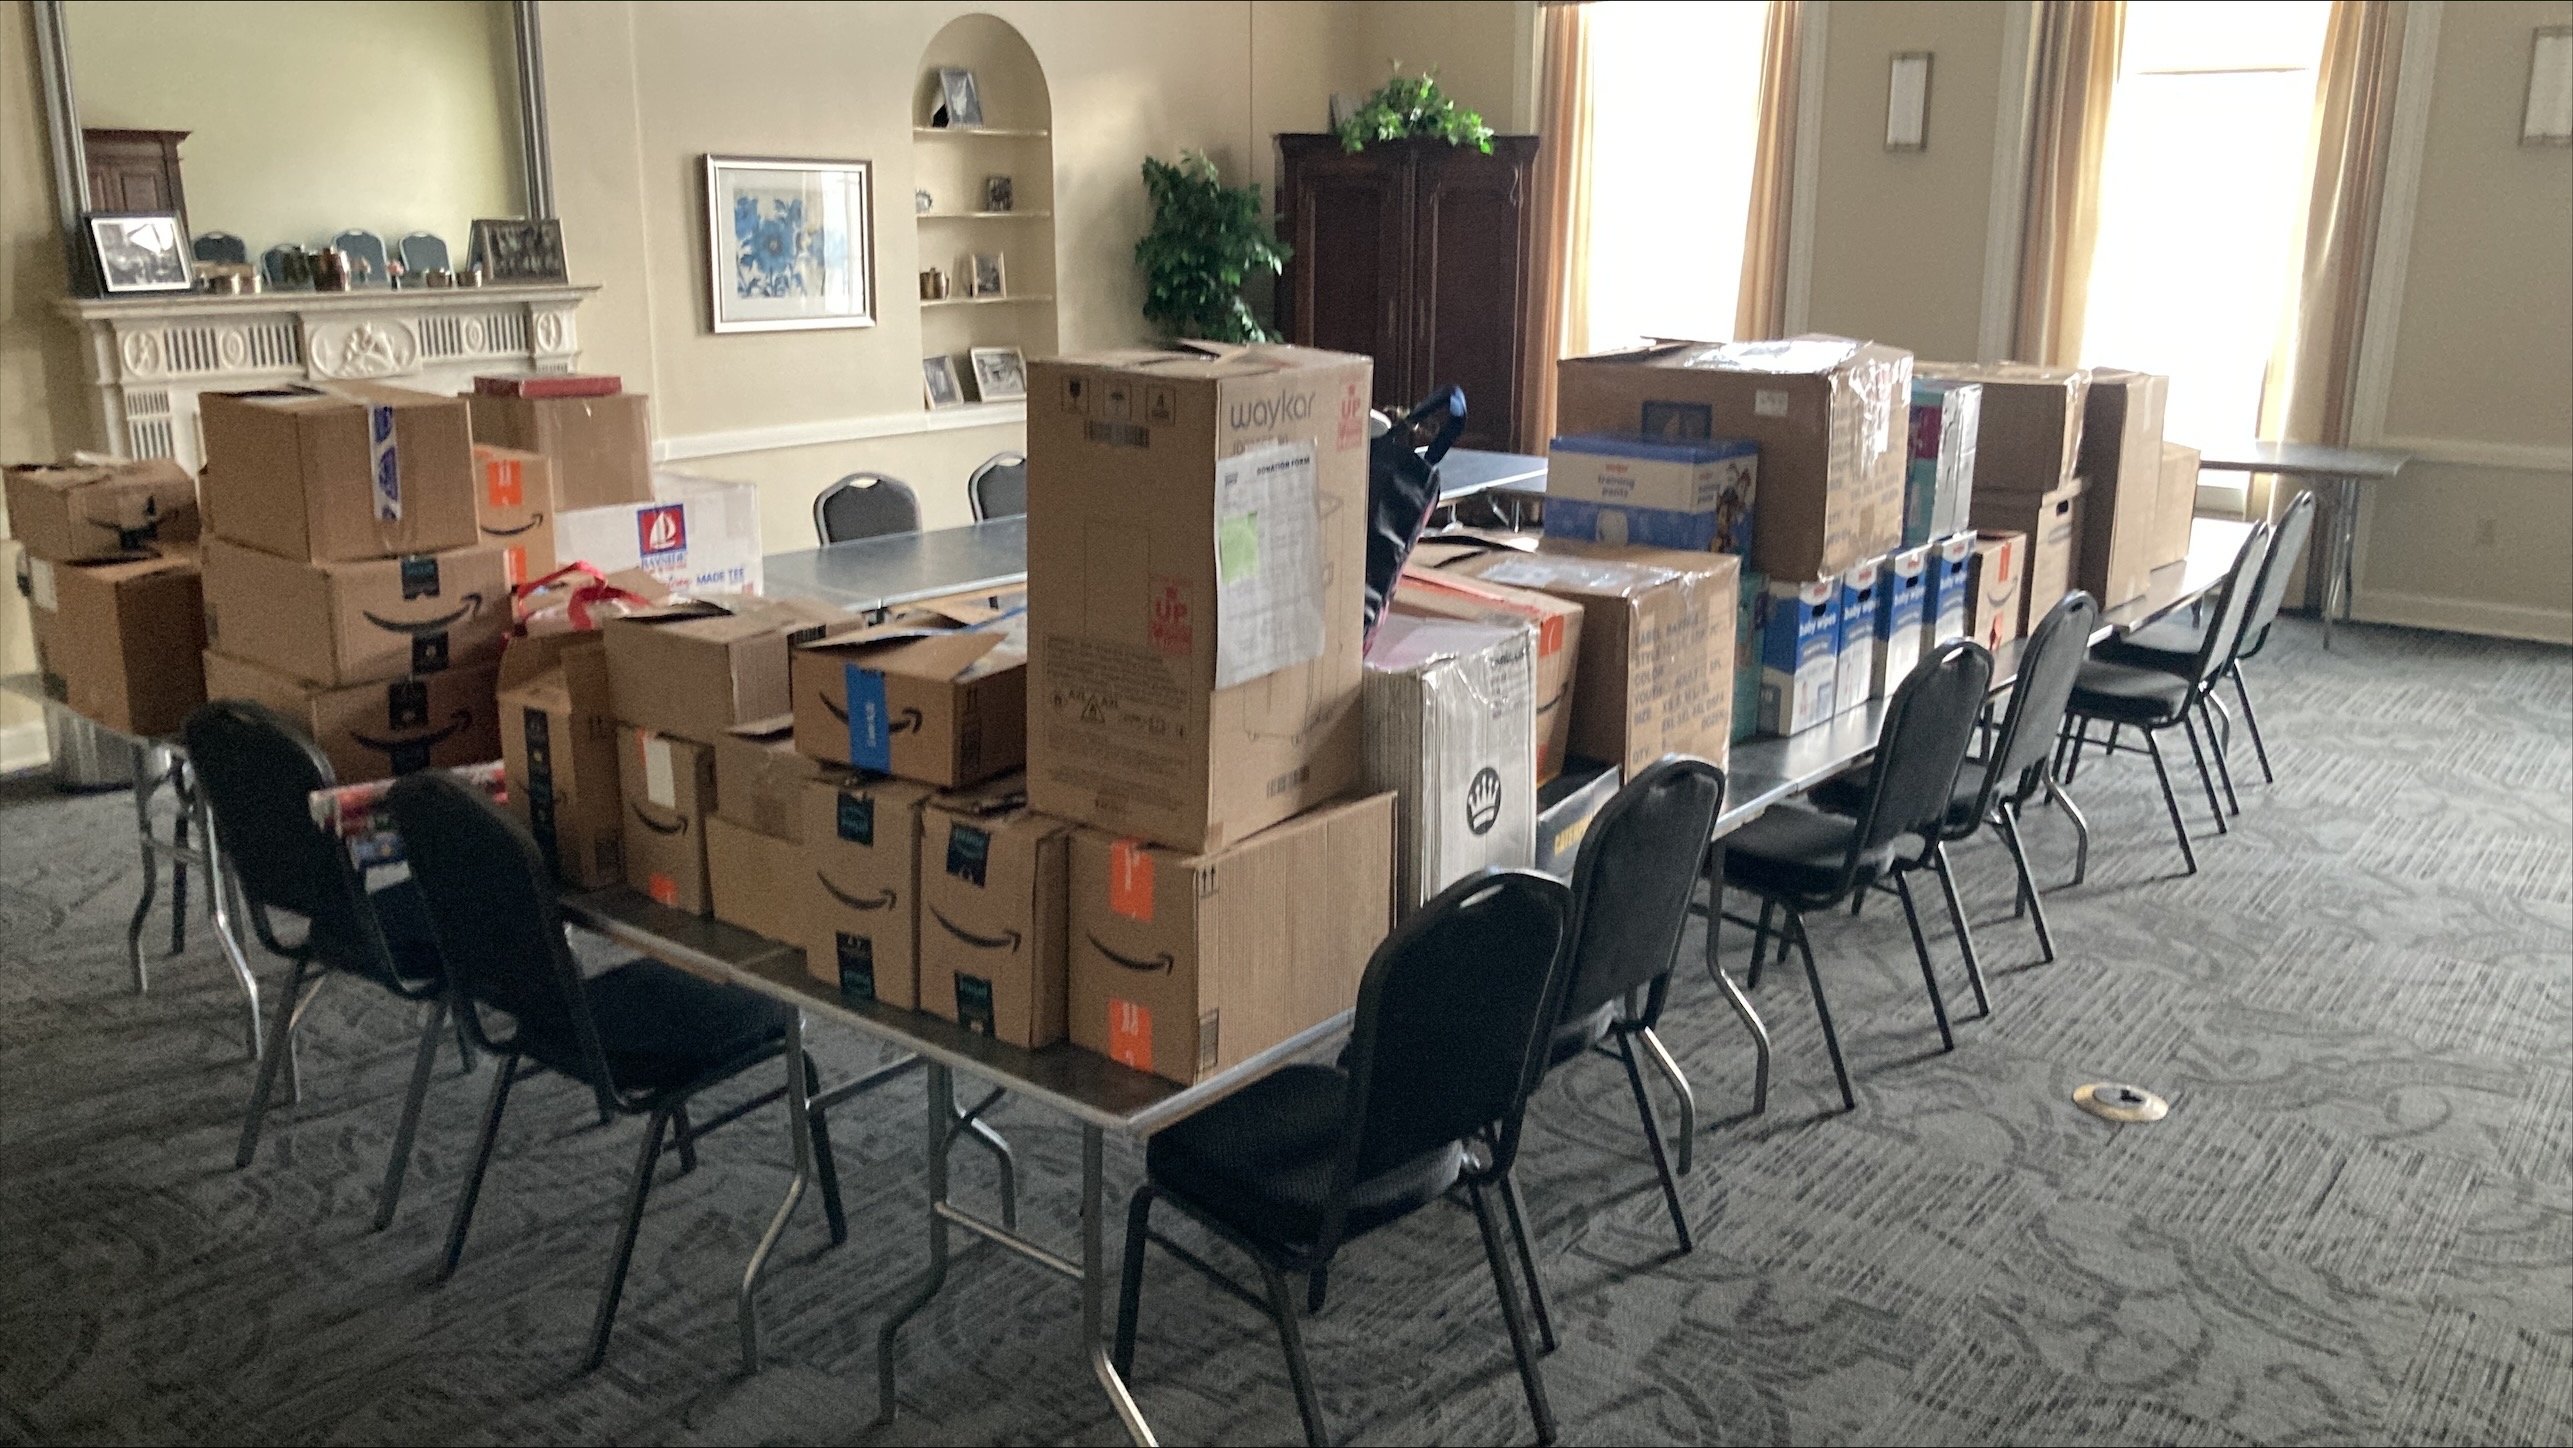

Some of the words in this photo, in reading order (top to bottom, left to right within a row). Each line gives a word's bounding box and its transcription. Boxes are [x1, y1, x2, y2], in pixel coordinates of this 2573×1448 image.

[1231, 387, 1317, 431] waykar
[1341, 397, 1361, 419] UP
[1256, 461, 1290, 477] DONATION
[1291, 455, 1311, 468] FORM
[696, 571, 726, 586] MADE
[1155, 598, 1188, 624] UP
[1799, 618, 1816, 638] baby
[1816, 611, 1837, 630] wipes
